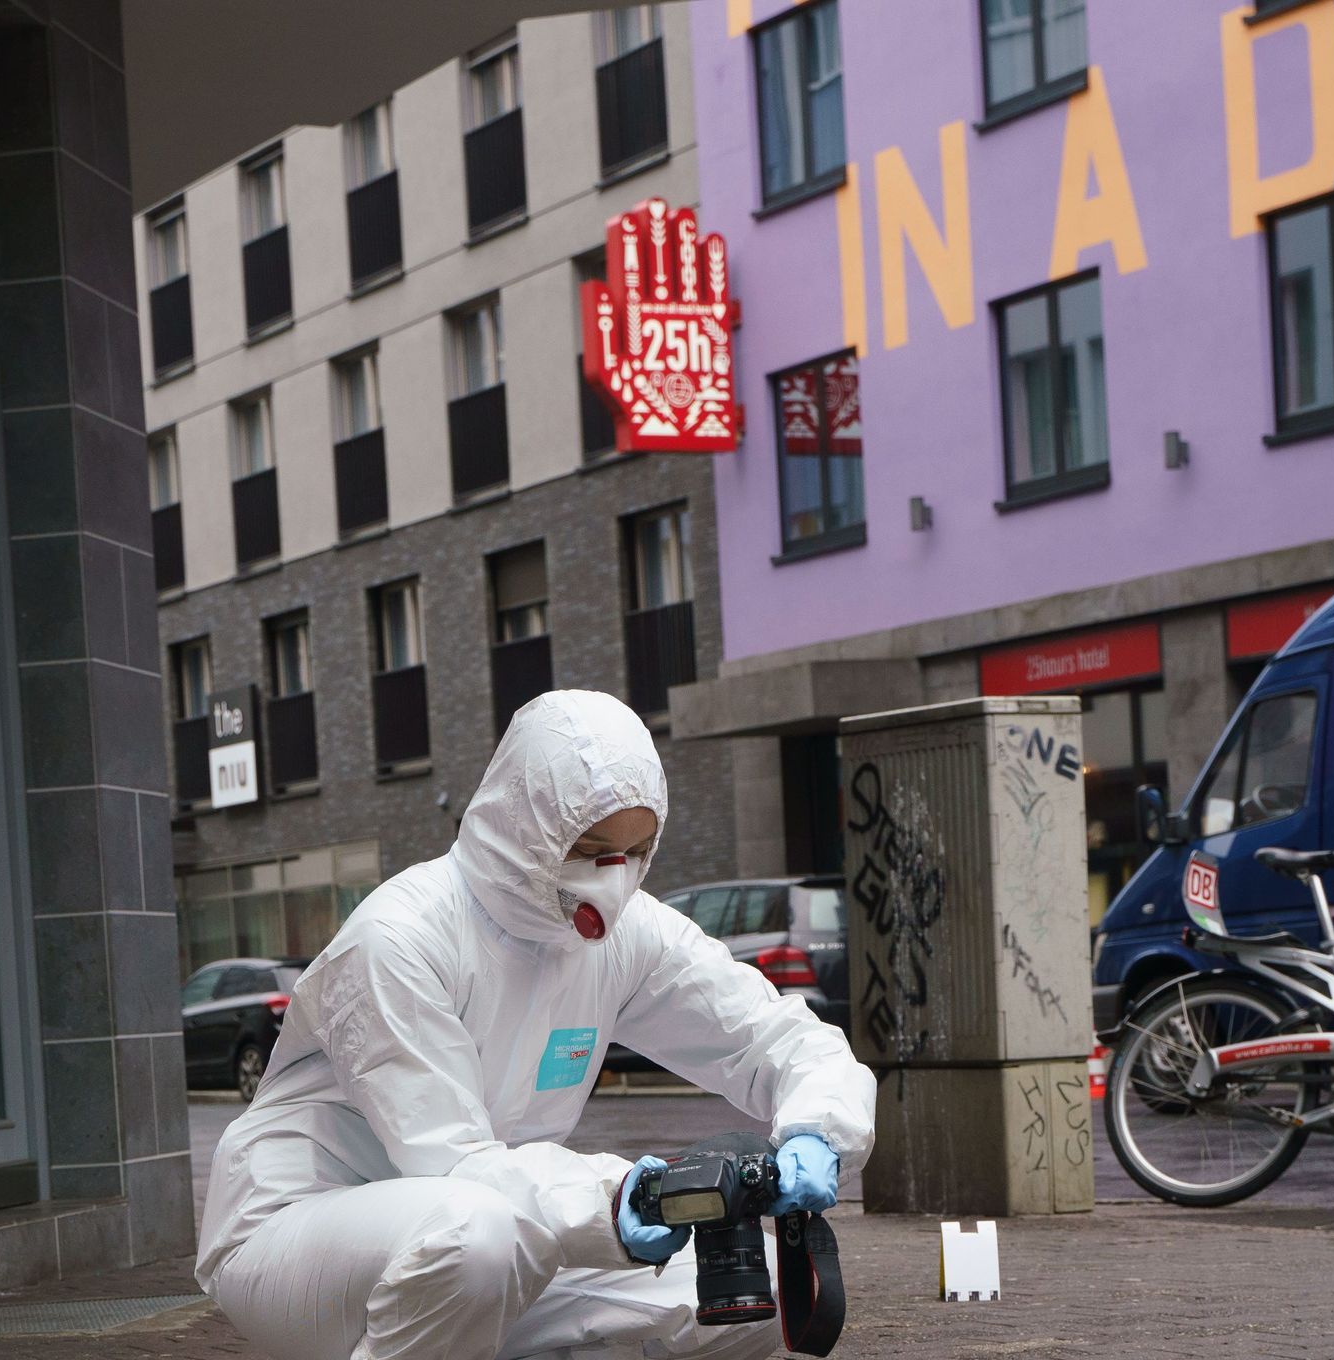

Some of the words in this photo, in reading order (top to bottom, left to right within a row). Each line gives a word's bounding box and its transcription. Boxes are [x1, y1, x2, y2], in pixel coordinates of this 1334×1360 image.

[835, 121, 974, 358] IN
[1048, 66, 1148, 282] A
[642, 319, 712, 373] 25h
[1026, 653, 1076, 682] 25hours
[1076, 642, 1110, 672] hotel
[214, 700, 244, 738] the
[218, 761, 247, 791] niu
[1192, 870, 1211, 900] DB
